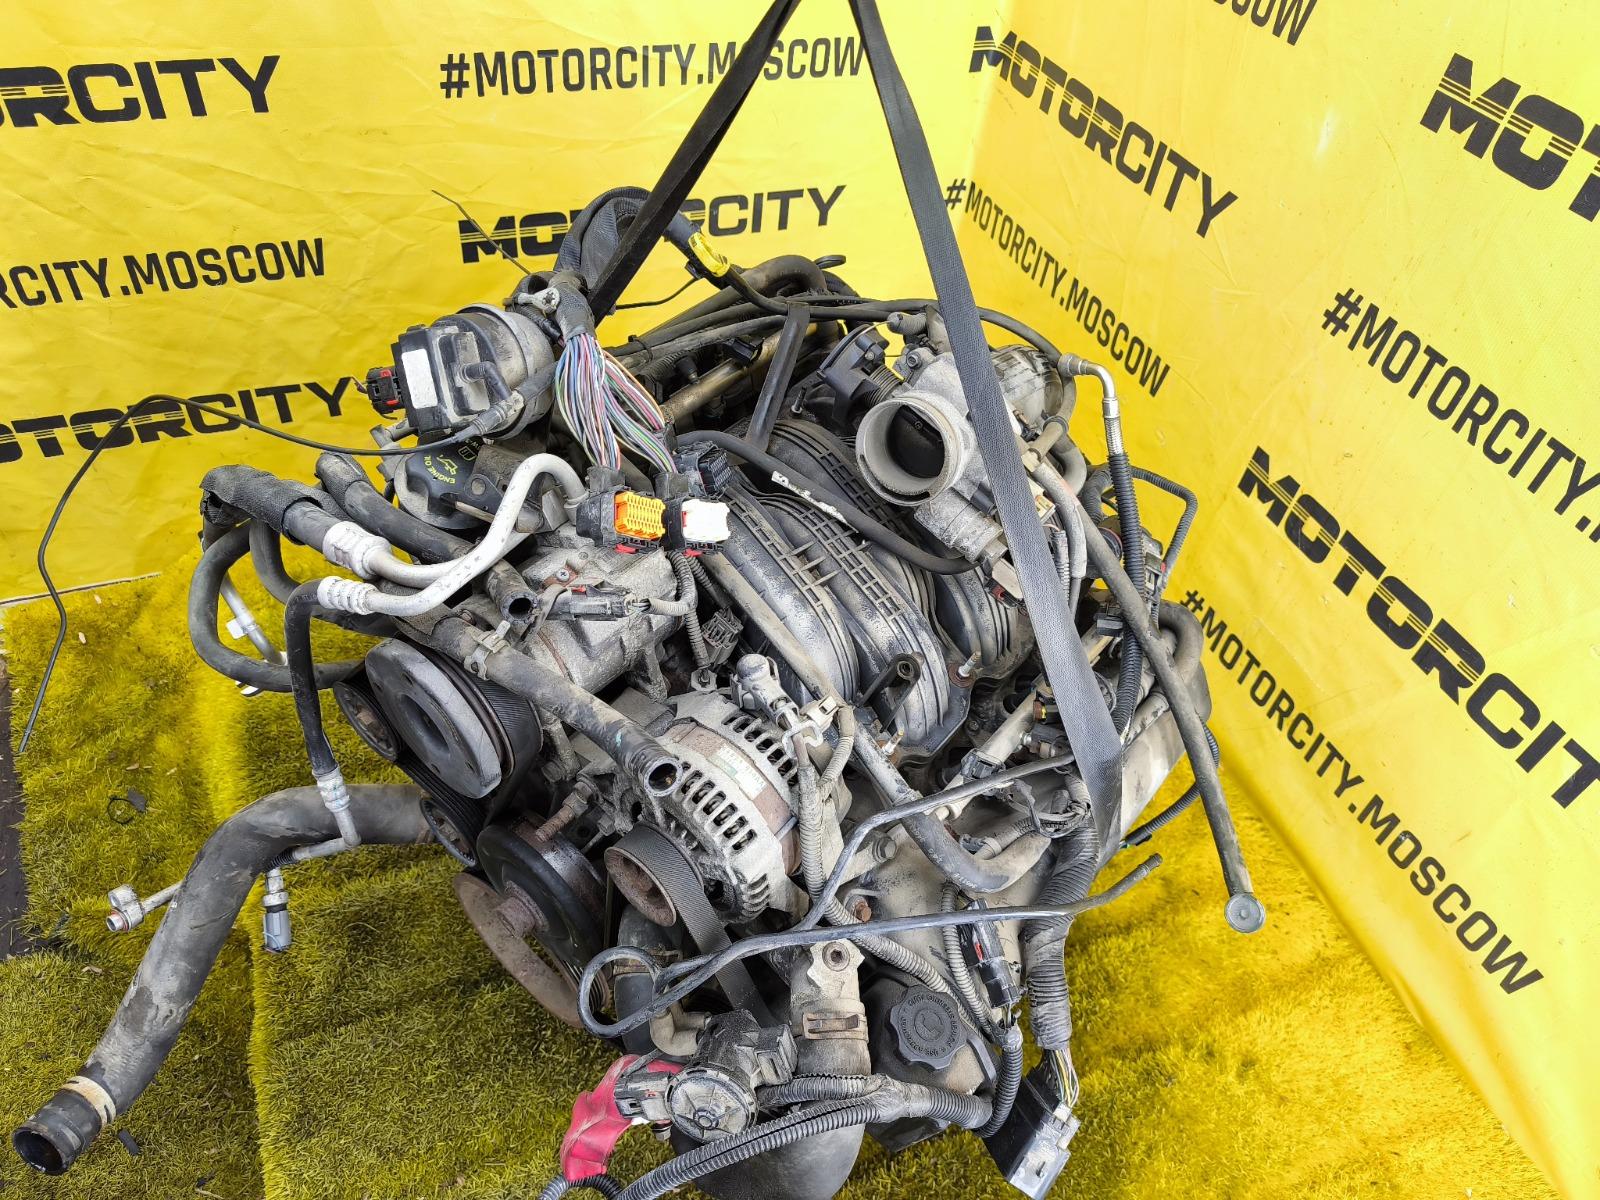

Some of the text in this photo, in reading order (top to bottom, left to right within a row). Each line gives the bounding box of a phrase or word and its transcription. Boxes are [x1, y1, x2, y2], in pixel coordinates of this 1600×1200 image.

[0, 55, 281, 128] RCITY
[440, 36, 866, 98] #MOTORCITY.MSCOW
[968, 26, 1238, 238] MOTORCITY
[1420, 52, 1600, 223] MO
[458, 184, 847, 264] MOCITY
[945, 178, 1170, 398] #MOTORCITY.MOSCOW
[427, 465, 456, 484] ENGINE
[1321, 287, 1600, 543] #MOTORCITY.
[1180, 590, 1545, 995] #MOTORCITY.MOSCOW
